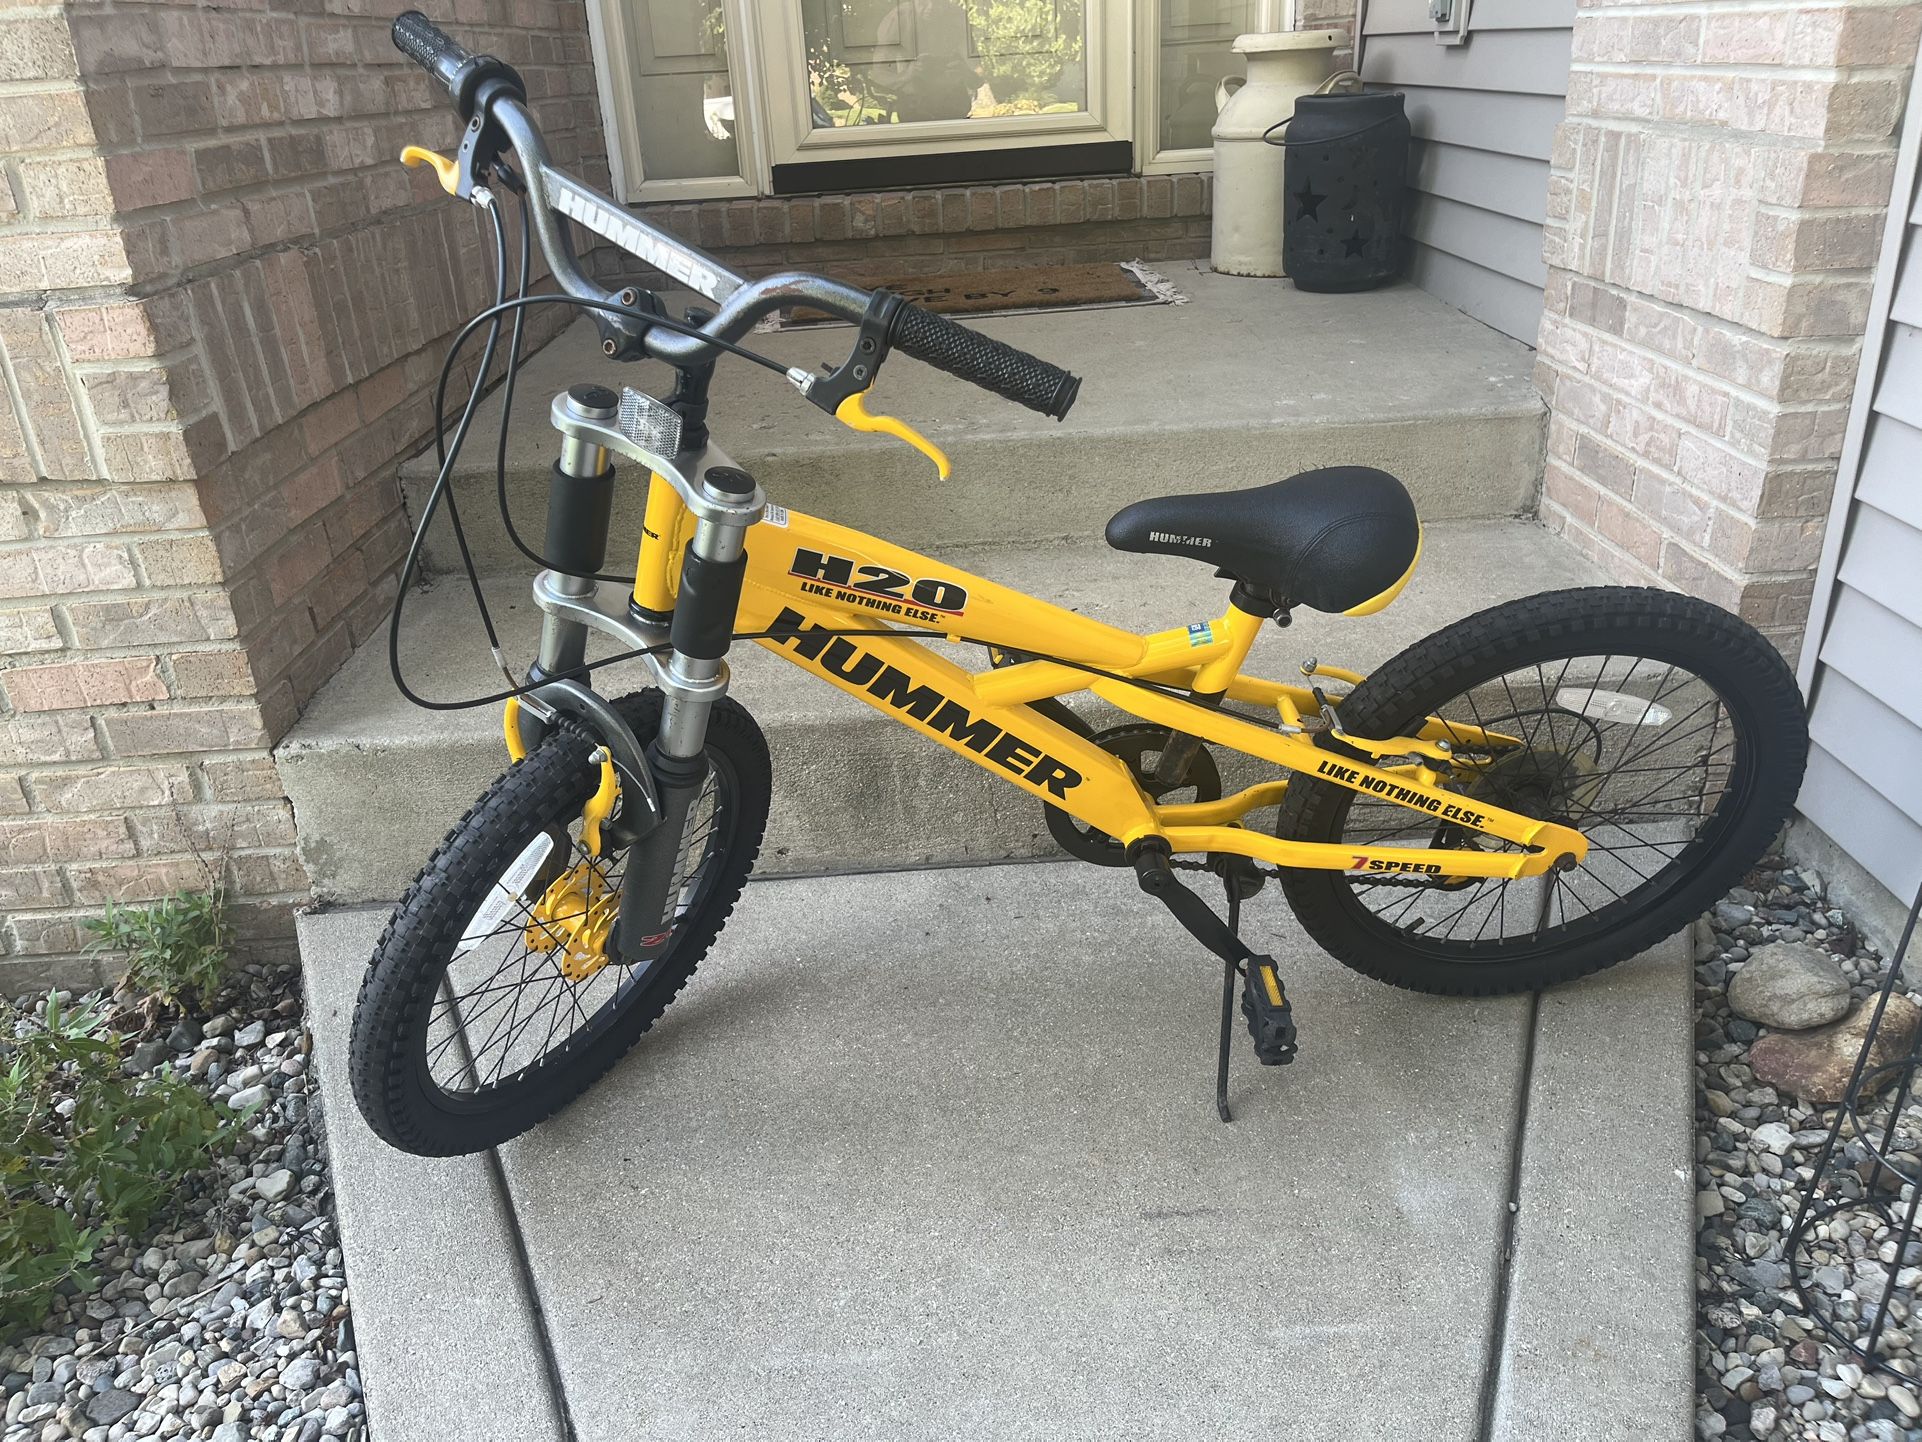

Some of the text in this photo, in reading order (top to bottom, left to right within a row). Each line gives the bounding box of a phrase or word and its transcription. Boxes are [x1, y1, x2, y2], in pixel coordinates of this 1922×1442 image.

[558, 187, 719, 300] HUMMER
[790, 547, 968, 611] H20
[800, 581, 833, 599] LIKE
[835, 590, 902, 615] NOTHING
[765, 606, 1083, 801] HUMMER
[1316, 760, 1360, 784] LIKE
[1359, 774, 1442, 813] NOTHING
[1350, 856, 1442, 874] 7 SPEED
